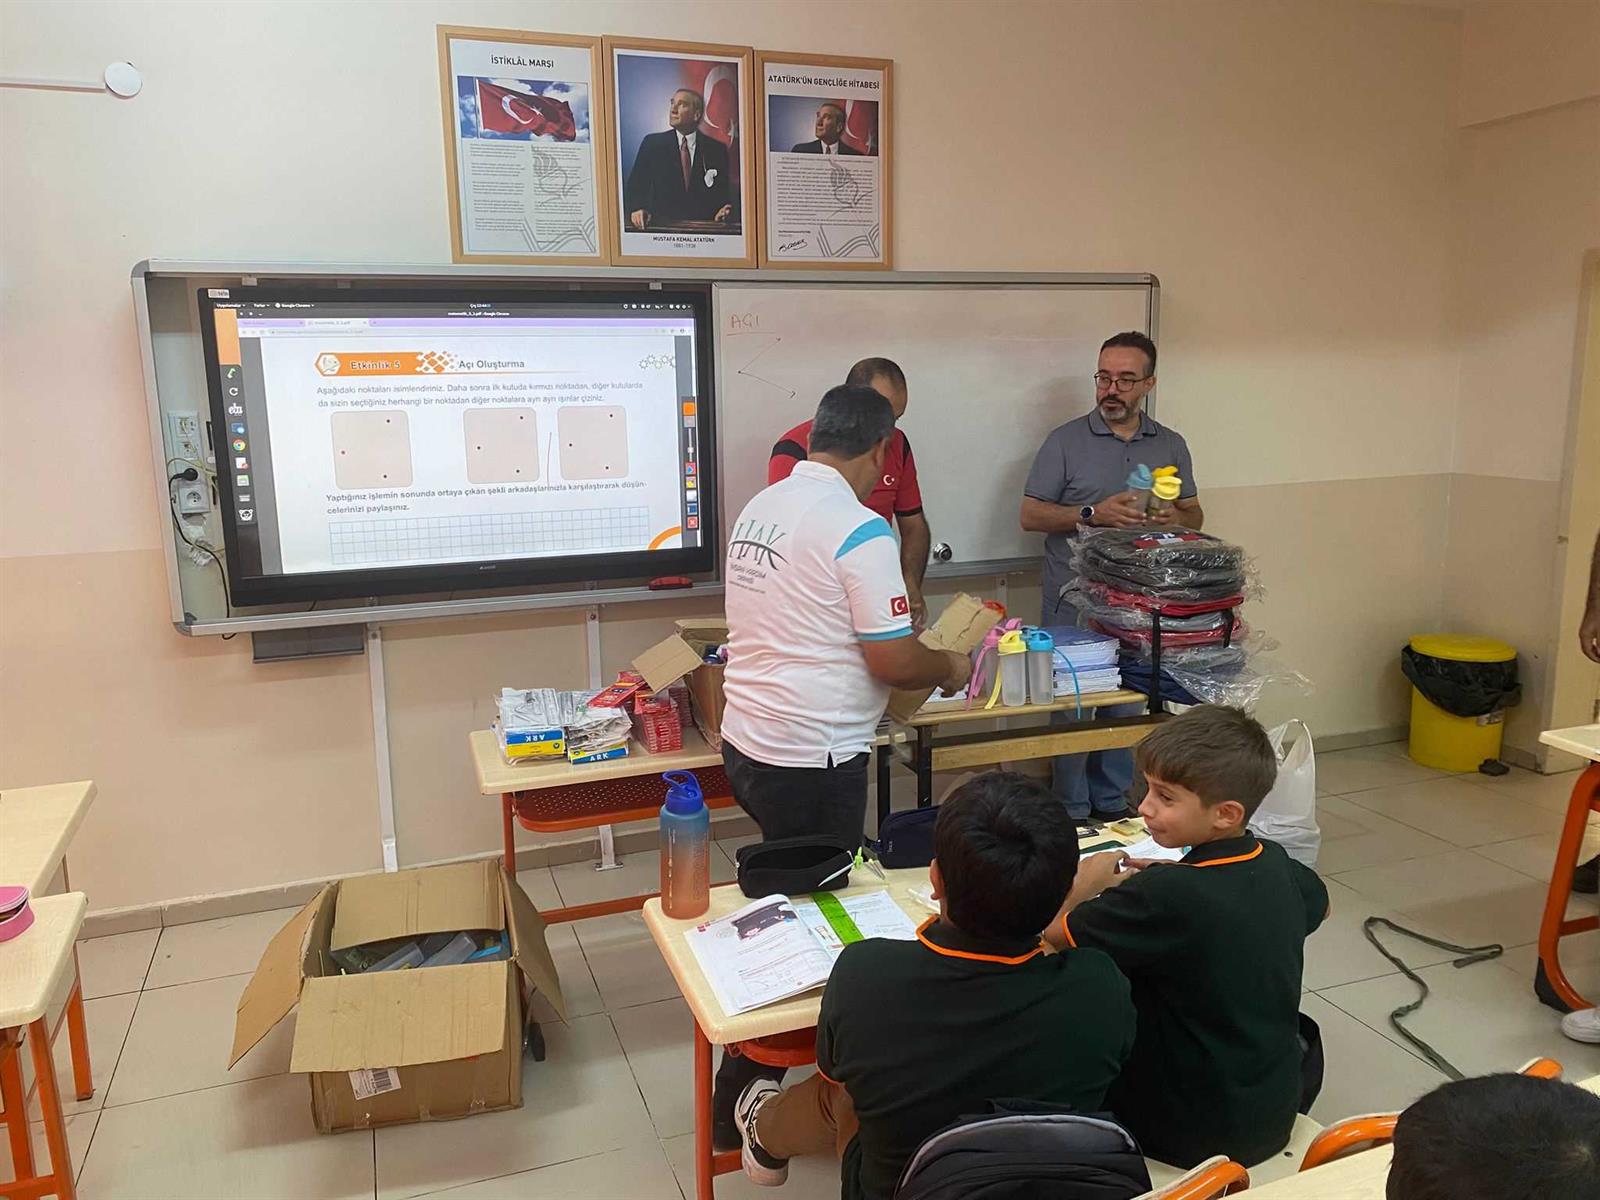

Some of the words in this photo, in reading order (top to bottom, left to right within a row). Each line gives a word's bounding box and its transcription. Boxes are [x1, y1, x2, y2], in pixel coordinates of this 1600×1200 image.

[491, 54, 527, 66] İSTİKLÂL
[529, 59, 554, 68] MARŞI
[768, 75, 812, 85] ATATÜRK'ÜN
[813, 78, 848, 87] GENÇLİĞE
[848, 80, 880, 90] HİTABESİ
[351, 361, 390, 370] Etkinlik
[393, 361, 401, 369] 5
[459, 360, 474, 369] Açı
[476, 360, 525, 369] Oluşturma
[317, 386, 356, 395] Aşağıdaki
[358, 385, 392, 393] noktaları
[447, 384, 467, 392] Daha
[502, 383, 527, 391] kutuda
[591, 382, 609, 390] diğer
[330, 399, 349, 407] sizin
[350, 398, 386, 407] seçtiğiniz
[388, 398, 422, 406] herhangi
[424, 397, 434, 405] bir
[435, 397, 469, 405] noktadan
[471, 396, 490, 405] diğer
[326, 494, 366, 502] Yaptığınız
[369, 493, 398, 501] işlemin
[400, 490, 436, 499] sonunda
[437, 489, 462, 497] ortaya
[464, 488, 485, 496] çıkan
[508, 485, 567, 494] arkadaşlarınızla
[568, 482, 620, 491] karşılaştırarak
[327, 506, 364, 514] celerinizi
[525, 734, 546, 743] ARK
[590, 752, 609, 761] ARK
